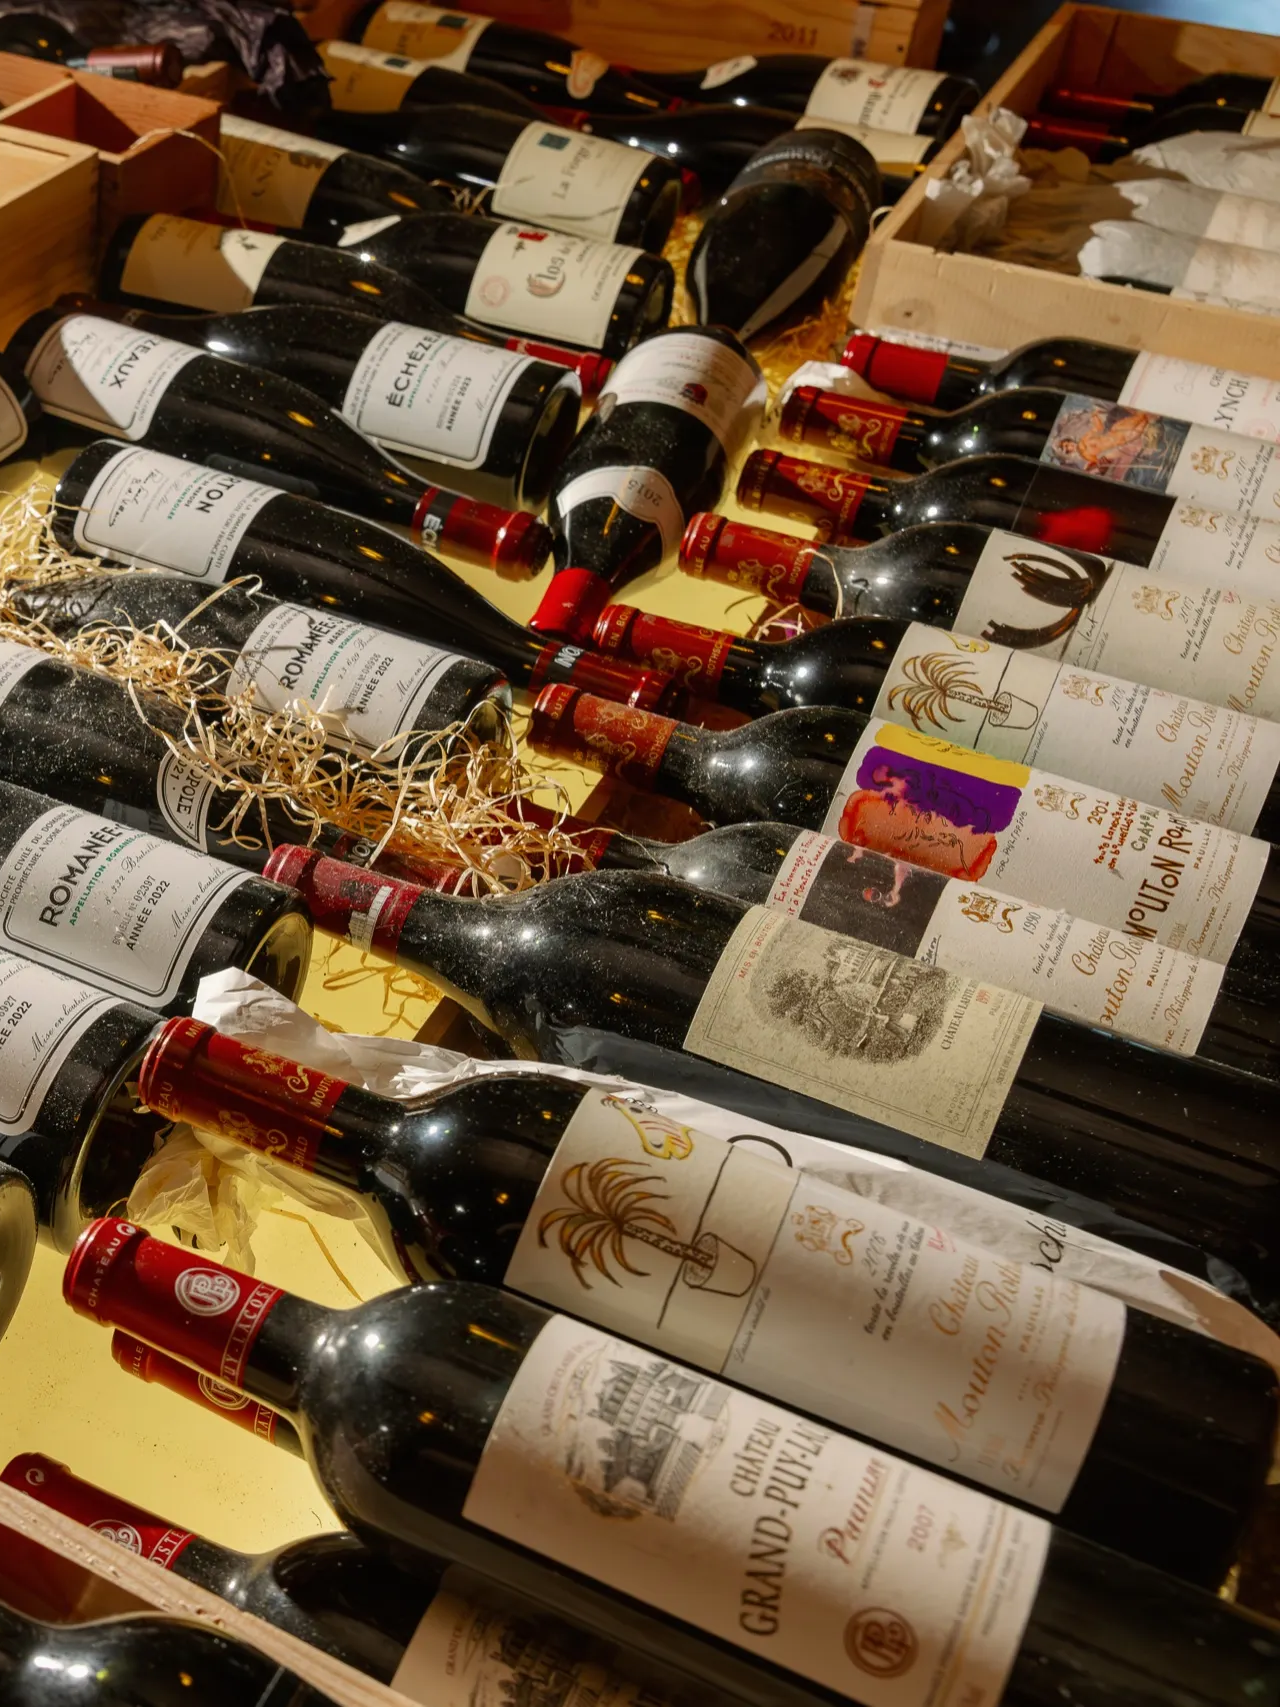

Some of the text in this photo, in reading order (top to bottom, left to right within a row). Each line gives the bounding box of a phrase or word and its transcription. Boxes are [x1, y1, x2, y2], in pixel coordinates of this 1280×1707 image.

[108, 339, 159, 389] ZEAUX
[385, 331, 442, 408] ÉCHÉZE
[196, 477, 242, 513] RTON
[310, 650, 340, 700] APPELLATION
[356, 656, 394, 714] ANNÉE 2022
[176, 769, 203, 815] OPOLE
[1160, 734, 1208, 813] Mouton
[15, 848, 33, 871] CIVILE
[31, 833, 42, 844] DU
[69, 865, 106, 926] APPELLATION
[133, 875, 157, 901] 02397
[126, 880, 171, 951] ANNÉE 2022
[1022, 911, 1042, 935] 1990
[8, 1000, 33, 1026] 2022
[1099, 967, 1133, 1027] outon
[158, 1081, 174, 1110] TEAU
[310, 1075, 336, 1108] MOUTO
[935, 1323, 1008, 1463] Mouton
[729, 1418, 781, 1498] CHÂTEAU
[907, 1504, 935, 1552] 2007
